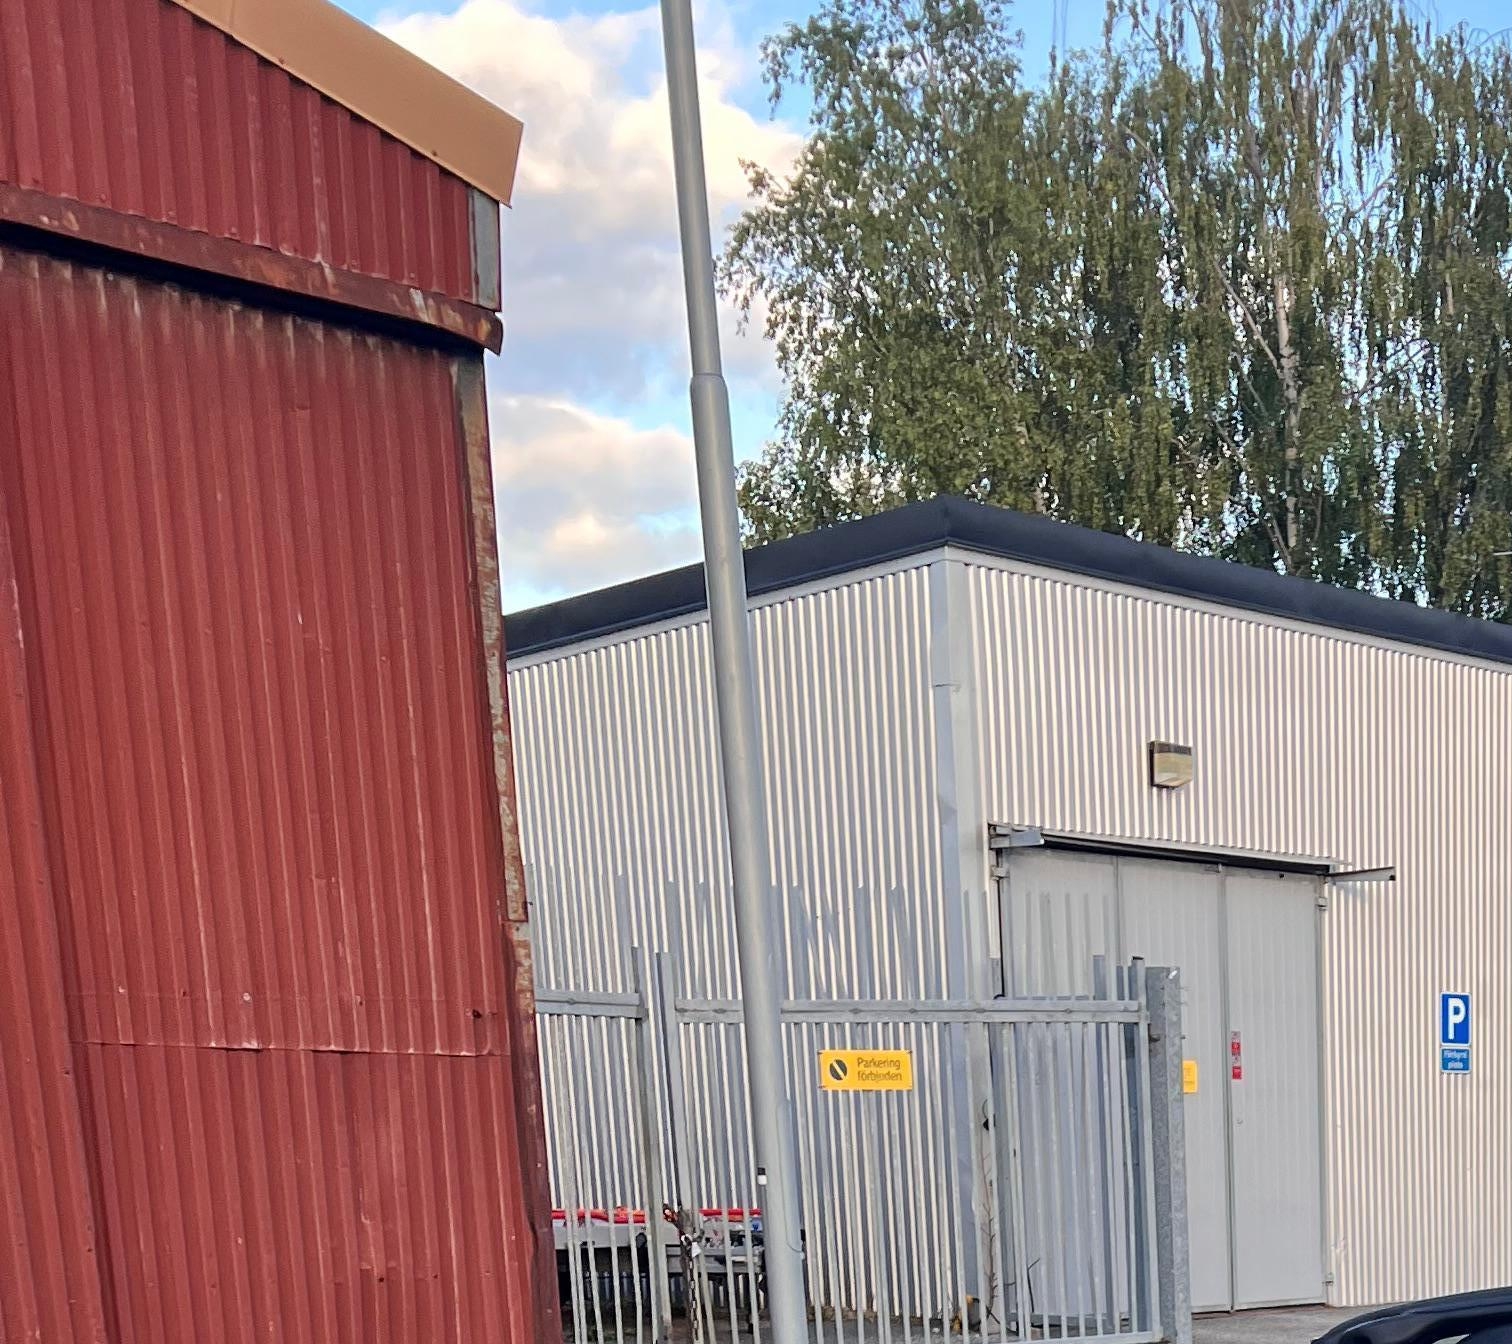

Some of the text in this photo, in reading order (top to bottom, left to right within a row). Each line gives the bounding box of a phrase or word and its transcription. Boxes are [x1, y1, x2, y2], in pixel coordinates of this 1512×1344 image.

[1448, 997, 1467, 1040] P
[857, 1057, 901, 1070] Parkering
[857, 1070, 903, 1083] förbjuden
